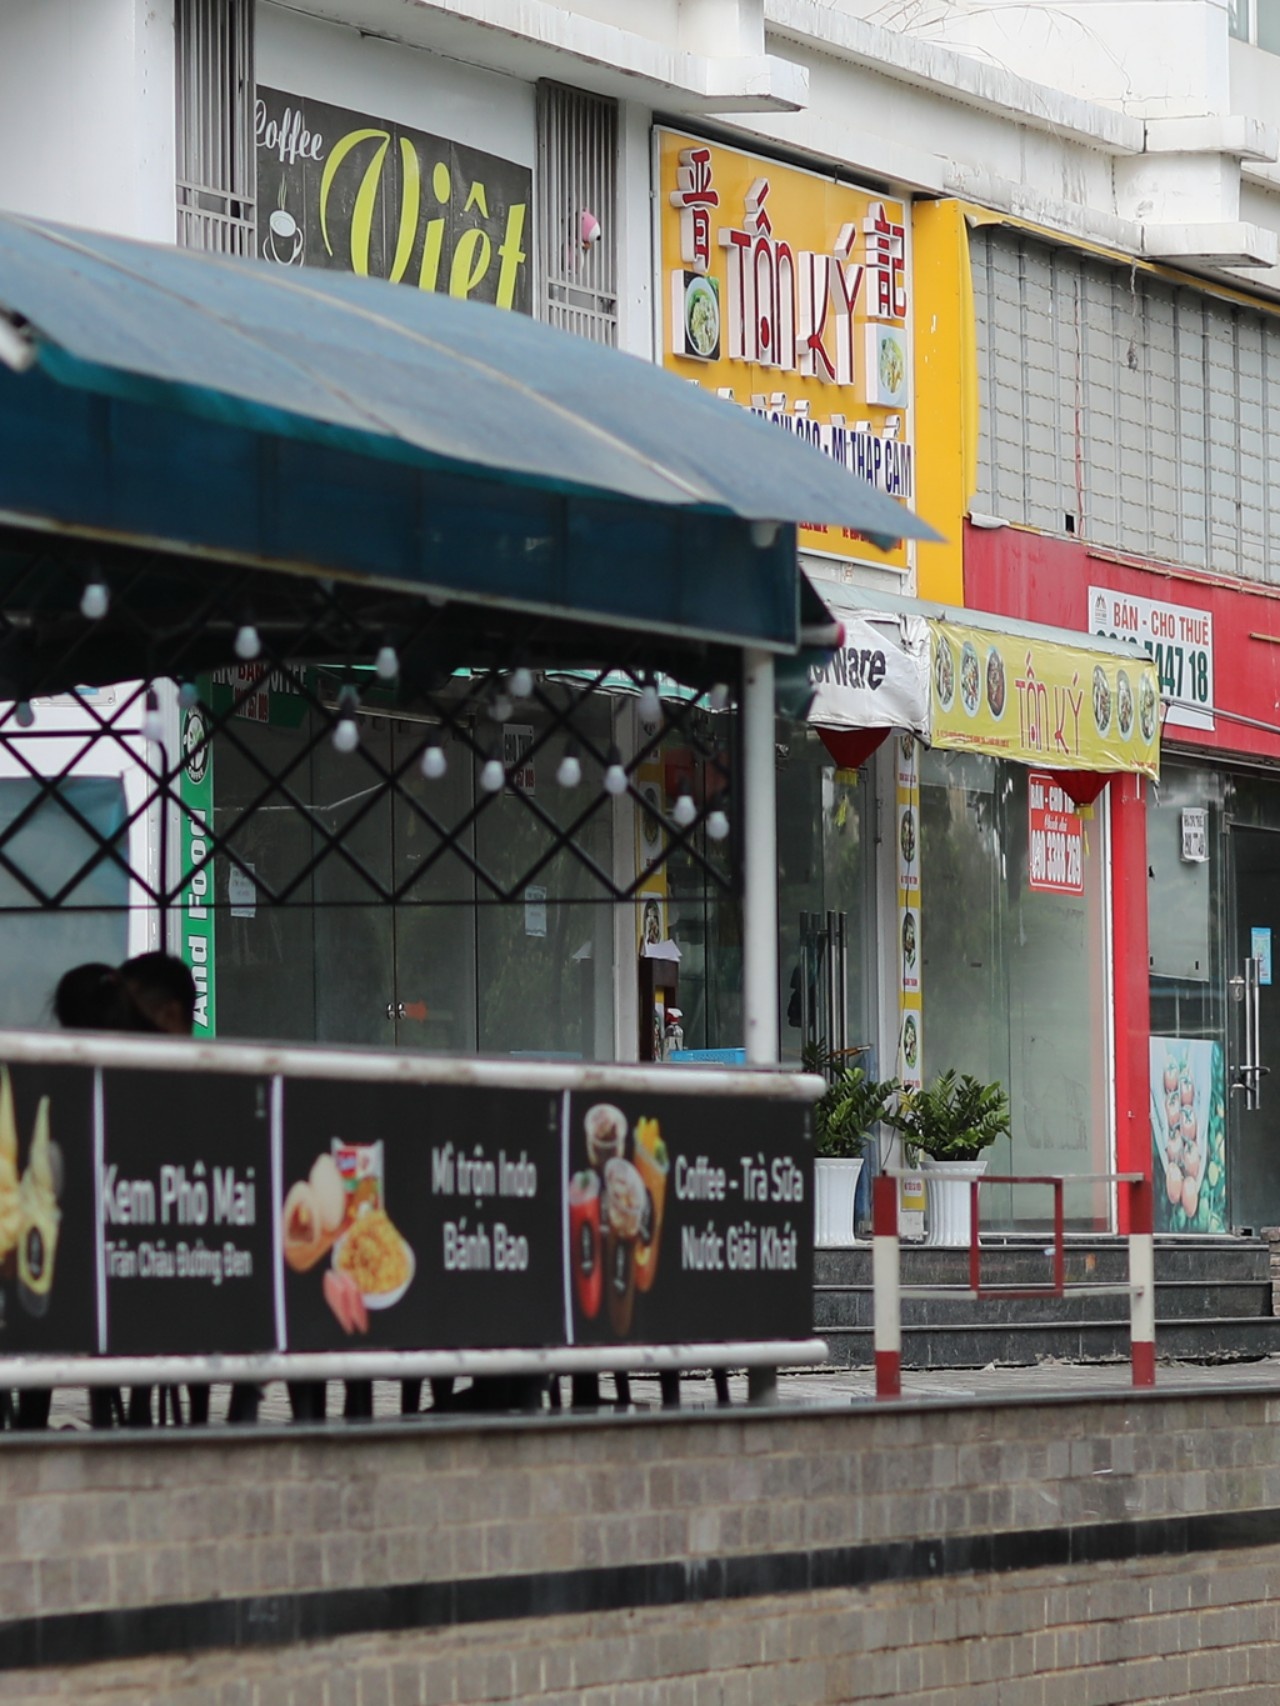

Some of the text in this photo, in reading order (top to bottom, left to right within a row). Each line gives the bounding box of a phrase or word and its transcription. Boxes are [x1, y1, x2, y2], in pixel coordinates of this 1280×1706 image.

[1113, 599, 1139, 632] BÁN
[1150, 610, 1176, 640] CHO
[1178, 615, 1210, 647] THUÊ
[1188, 649, 1209, 703] 18
[102, 1160, 256, 1226] Kem Phô Mai
[674, 1154, 726, 1200] Coffee
[740, 1152, 768, 1202] Trà
[771, 1156, 804, 1202] Sữa
[443, 1216, 529, 1271] Bánh Bao
[681, 1220, 798, 1272] Nước Giải Khát
